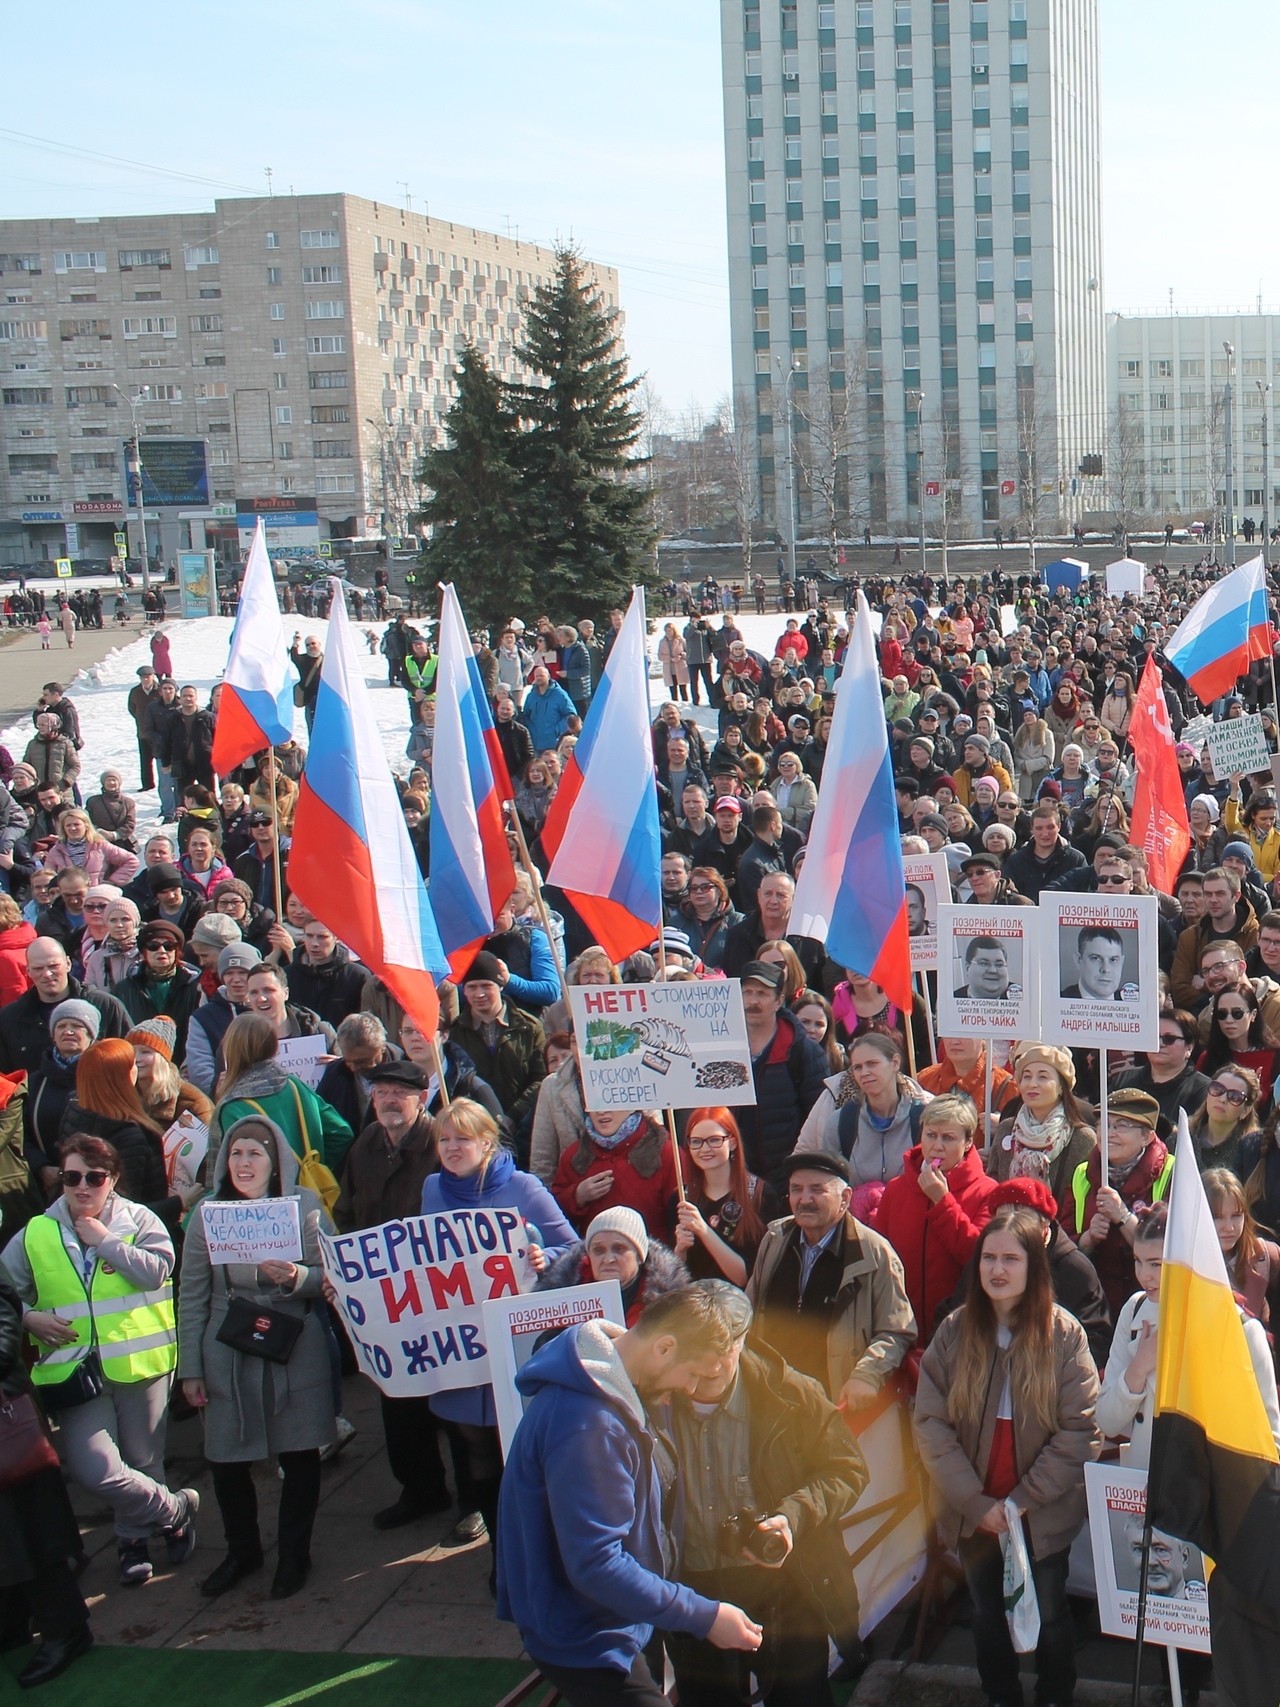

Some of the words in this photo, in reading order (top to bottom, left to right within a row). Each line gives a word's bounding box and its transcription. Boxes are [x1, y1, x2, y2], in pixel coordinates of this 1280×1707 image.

[1207, 726, 1217, 735] ЗА
[1220, 720, 1243, 732] НАШИ
[1244, 724, 1264, 738] НЕФТЬ
[1215, 748, 1257, 766] ДЕРЬМОМ
[1220, 756, 1268, 776] ЗАПЛАТИЛА
[915, 865, 933, 874] ПОЛК
[1059, 905, 1110, 917] ПОЗОРНЫЙ
[1113, 907, 1139, 919] ПОЛК
[953, 917, 998, 928] ПОЗОРНЫЙ
[1000, 919, 1024, 929] ПОЛК
[1063, 918, 1094, 926] ВЛАСТЬ
[1102, 920, 1135, 928] ОТВЕТУ!
[911, 952, 938, 960] ПОНОМАР
[584, 989, 648, 1014] НЕТ!
[652, 985, 731, 1003] СТОЛИЧНОМУ
[682, 1002, 729, 1019] МУСОРУ
[981, 1008, 1020, 1016] ГЕНПРОКУРОРА
[710, 1021, 730, 1037] НА
[961, 1015, 987, 1026] ИГОРЬ
[989, 1015, 1017, 1027] ЧАЙКА
[1061, 1019, 1092, 1032] АНДРЕЙ
[1095, 1022, 1140, 1033] МАЛЫШЕВ
[590, 1066, 641, 1087] РУССКОМ
[602, 1083, 658, 1104] СЕВЕРЕ!
[211, 1220, 295, 1241] ЧЕЛОВЕКОМ
[379, 1255, 520, 1325] ИМЯ
[509, 1302, 569, 1324] ПОЗОРНЫЙ
[572, 1298, 603, 1313] ПОЛК
[515, 1321, 553, 1334] ВЛАСТЬ
[554, 1319, 561, 1327] К
[562, 1312, 600, 1325] ОТВЕТУ!
[401, 1324, 488, 1376] ЖИВ
[1105, 1486, 1148, 1503] ПОЗОРН
[1111, 1501, 1146, 1513] ВЛАСТЬ
[1153, 1601, 1197, 1613] АРХАНГЕЛЬСКОГО
[1121, 1613, 1161, 1630] ВИТЛИЙ
[1164, 1620, 1211, 1637] ФОРТЫГИН
[1182, 1612, 1195, 1621] ЧЛЕН
[1196, 1614, 1210, 1623] ЕДРА
